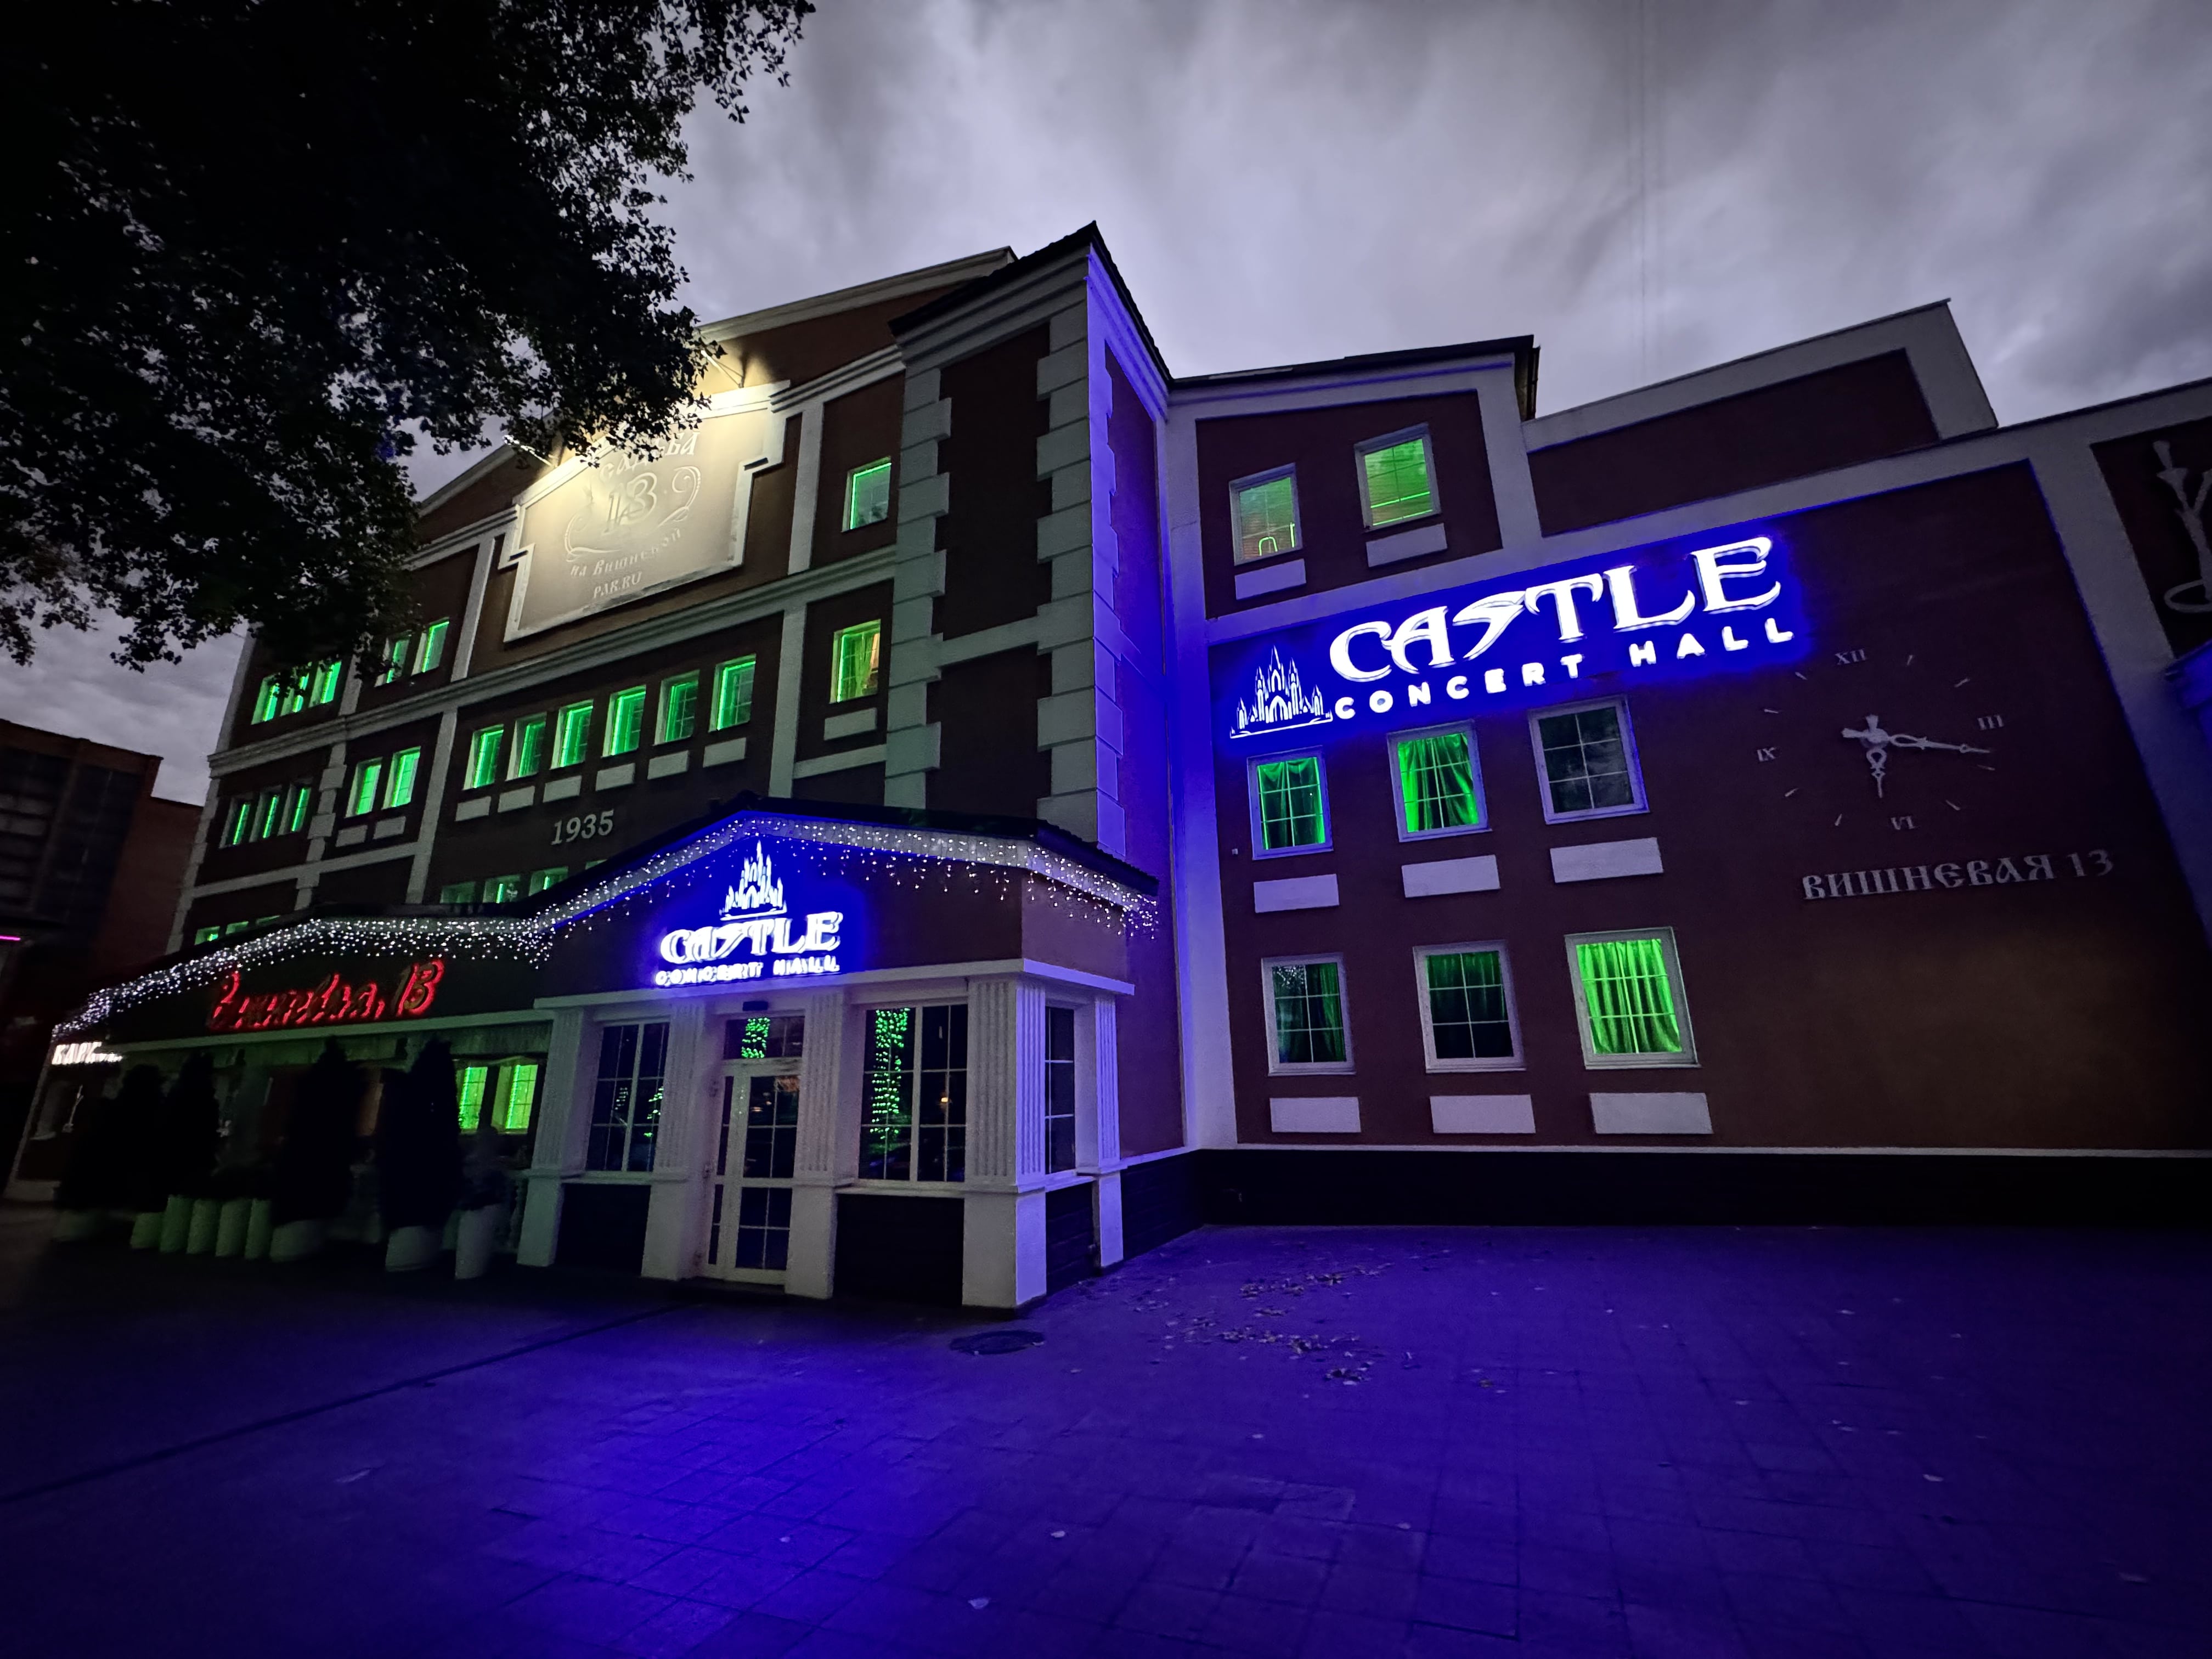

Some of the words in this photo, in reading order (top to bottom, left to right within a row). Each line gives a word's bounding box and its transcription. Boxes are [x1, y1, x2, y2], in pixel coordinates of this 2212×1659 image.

[601, 472, 657, 535] 13
[1329, 535, 1781, 683] CASTLE
[1334, 653, 1584, 720] CONCERT
[1628, 617, 1795, 668] HALL
[1835, 648, 1867, 665] XII
[1977, 714, 2005, 731] III
[1756, 746, 1780, 762] IX
[550, 809, 615, 846] 1935
[2066, 848, 2115, 878] 13
[659, 911, 843, 964] CASTLE
[654, 961, 764, 987] CONCERT
[772, 955, 840, 976] HALL
